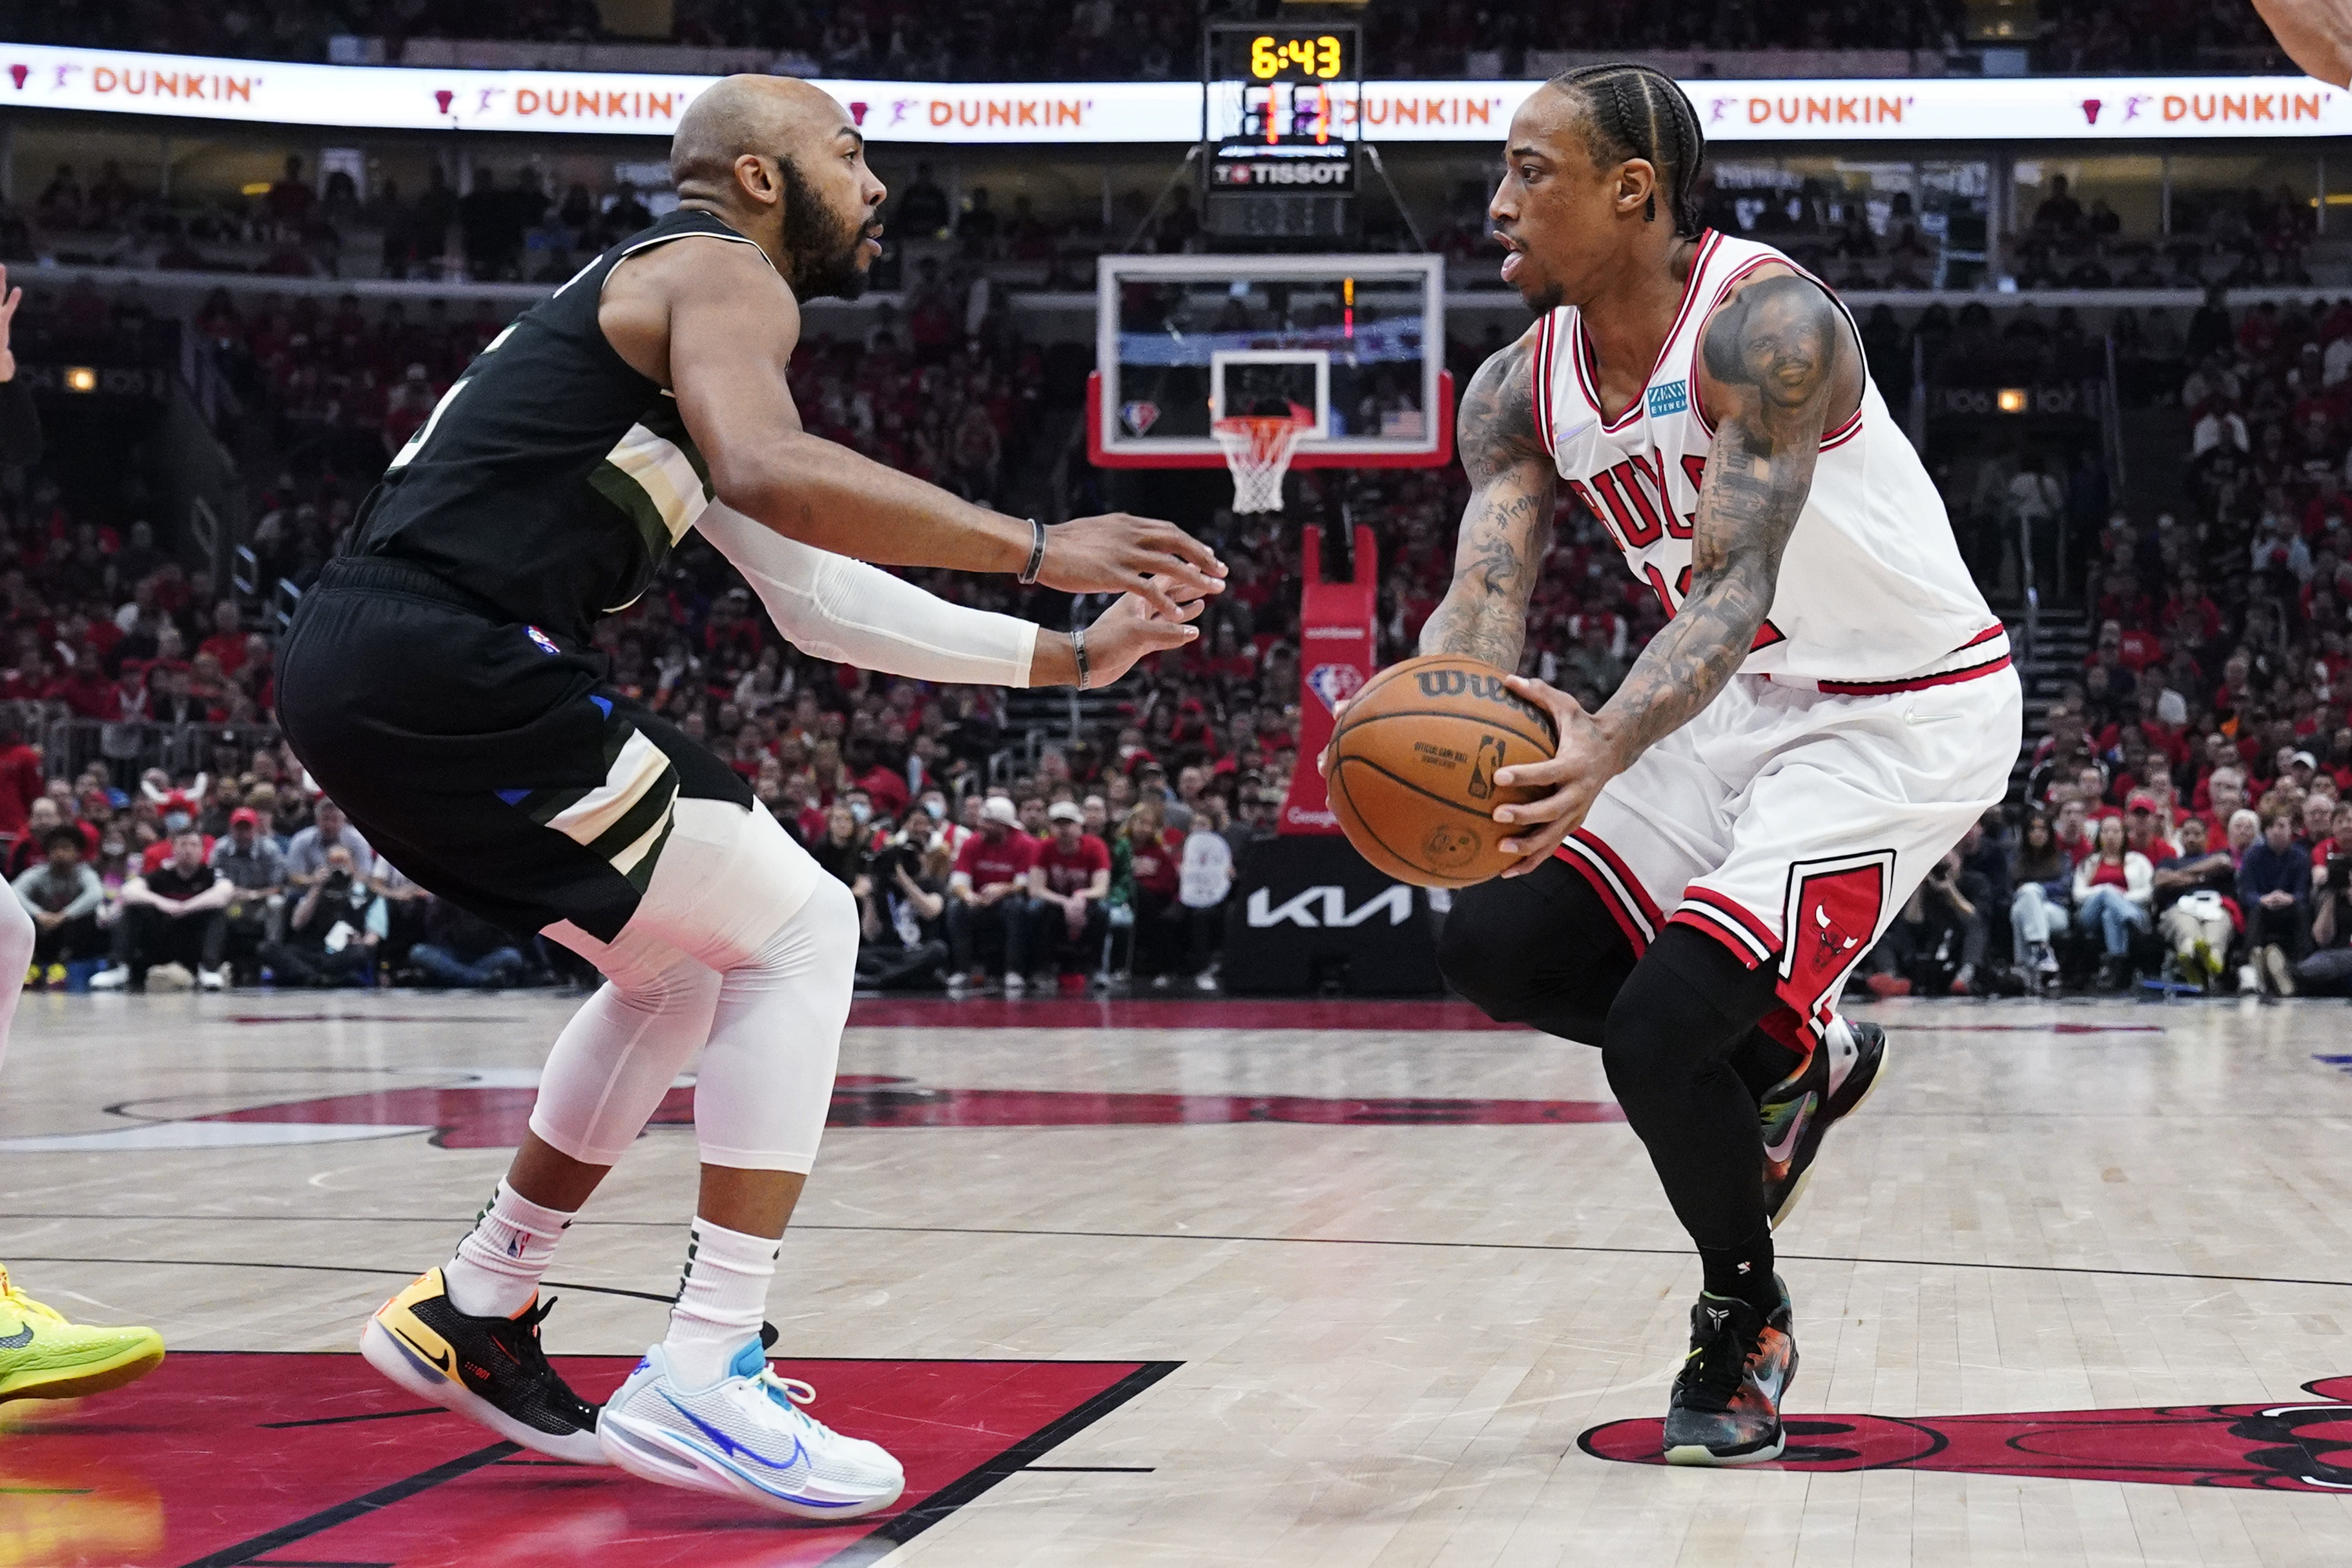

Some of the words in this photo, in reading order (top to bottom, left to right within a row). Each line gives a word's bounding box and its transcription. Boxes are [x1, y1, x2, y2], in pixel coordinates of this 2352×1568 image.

[1252, 36, 1341, 78] 6:43
[93, 66, 263, 102] DUNKIN'
[516, 89, 685, 119] DUNKIN'
[930, 100, 1093, 127] DUNKIN'
[1748, 97, 1913, 125] DUNKIN'
[2161, 93, 2331, 122] DUNKIN'
[1251, 163, 1350, 184] TISSOT
[1649, 382, 1685, 403] ZENN
[1651, 400, 1686, 414] EYEWEA
